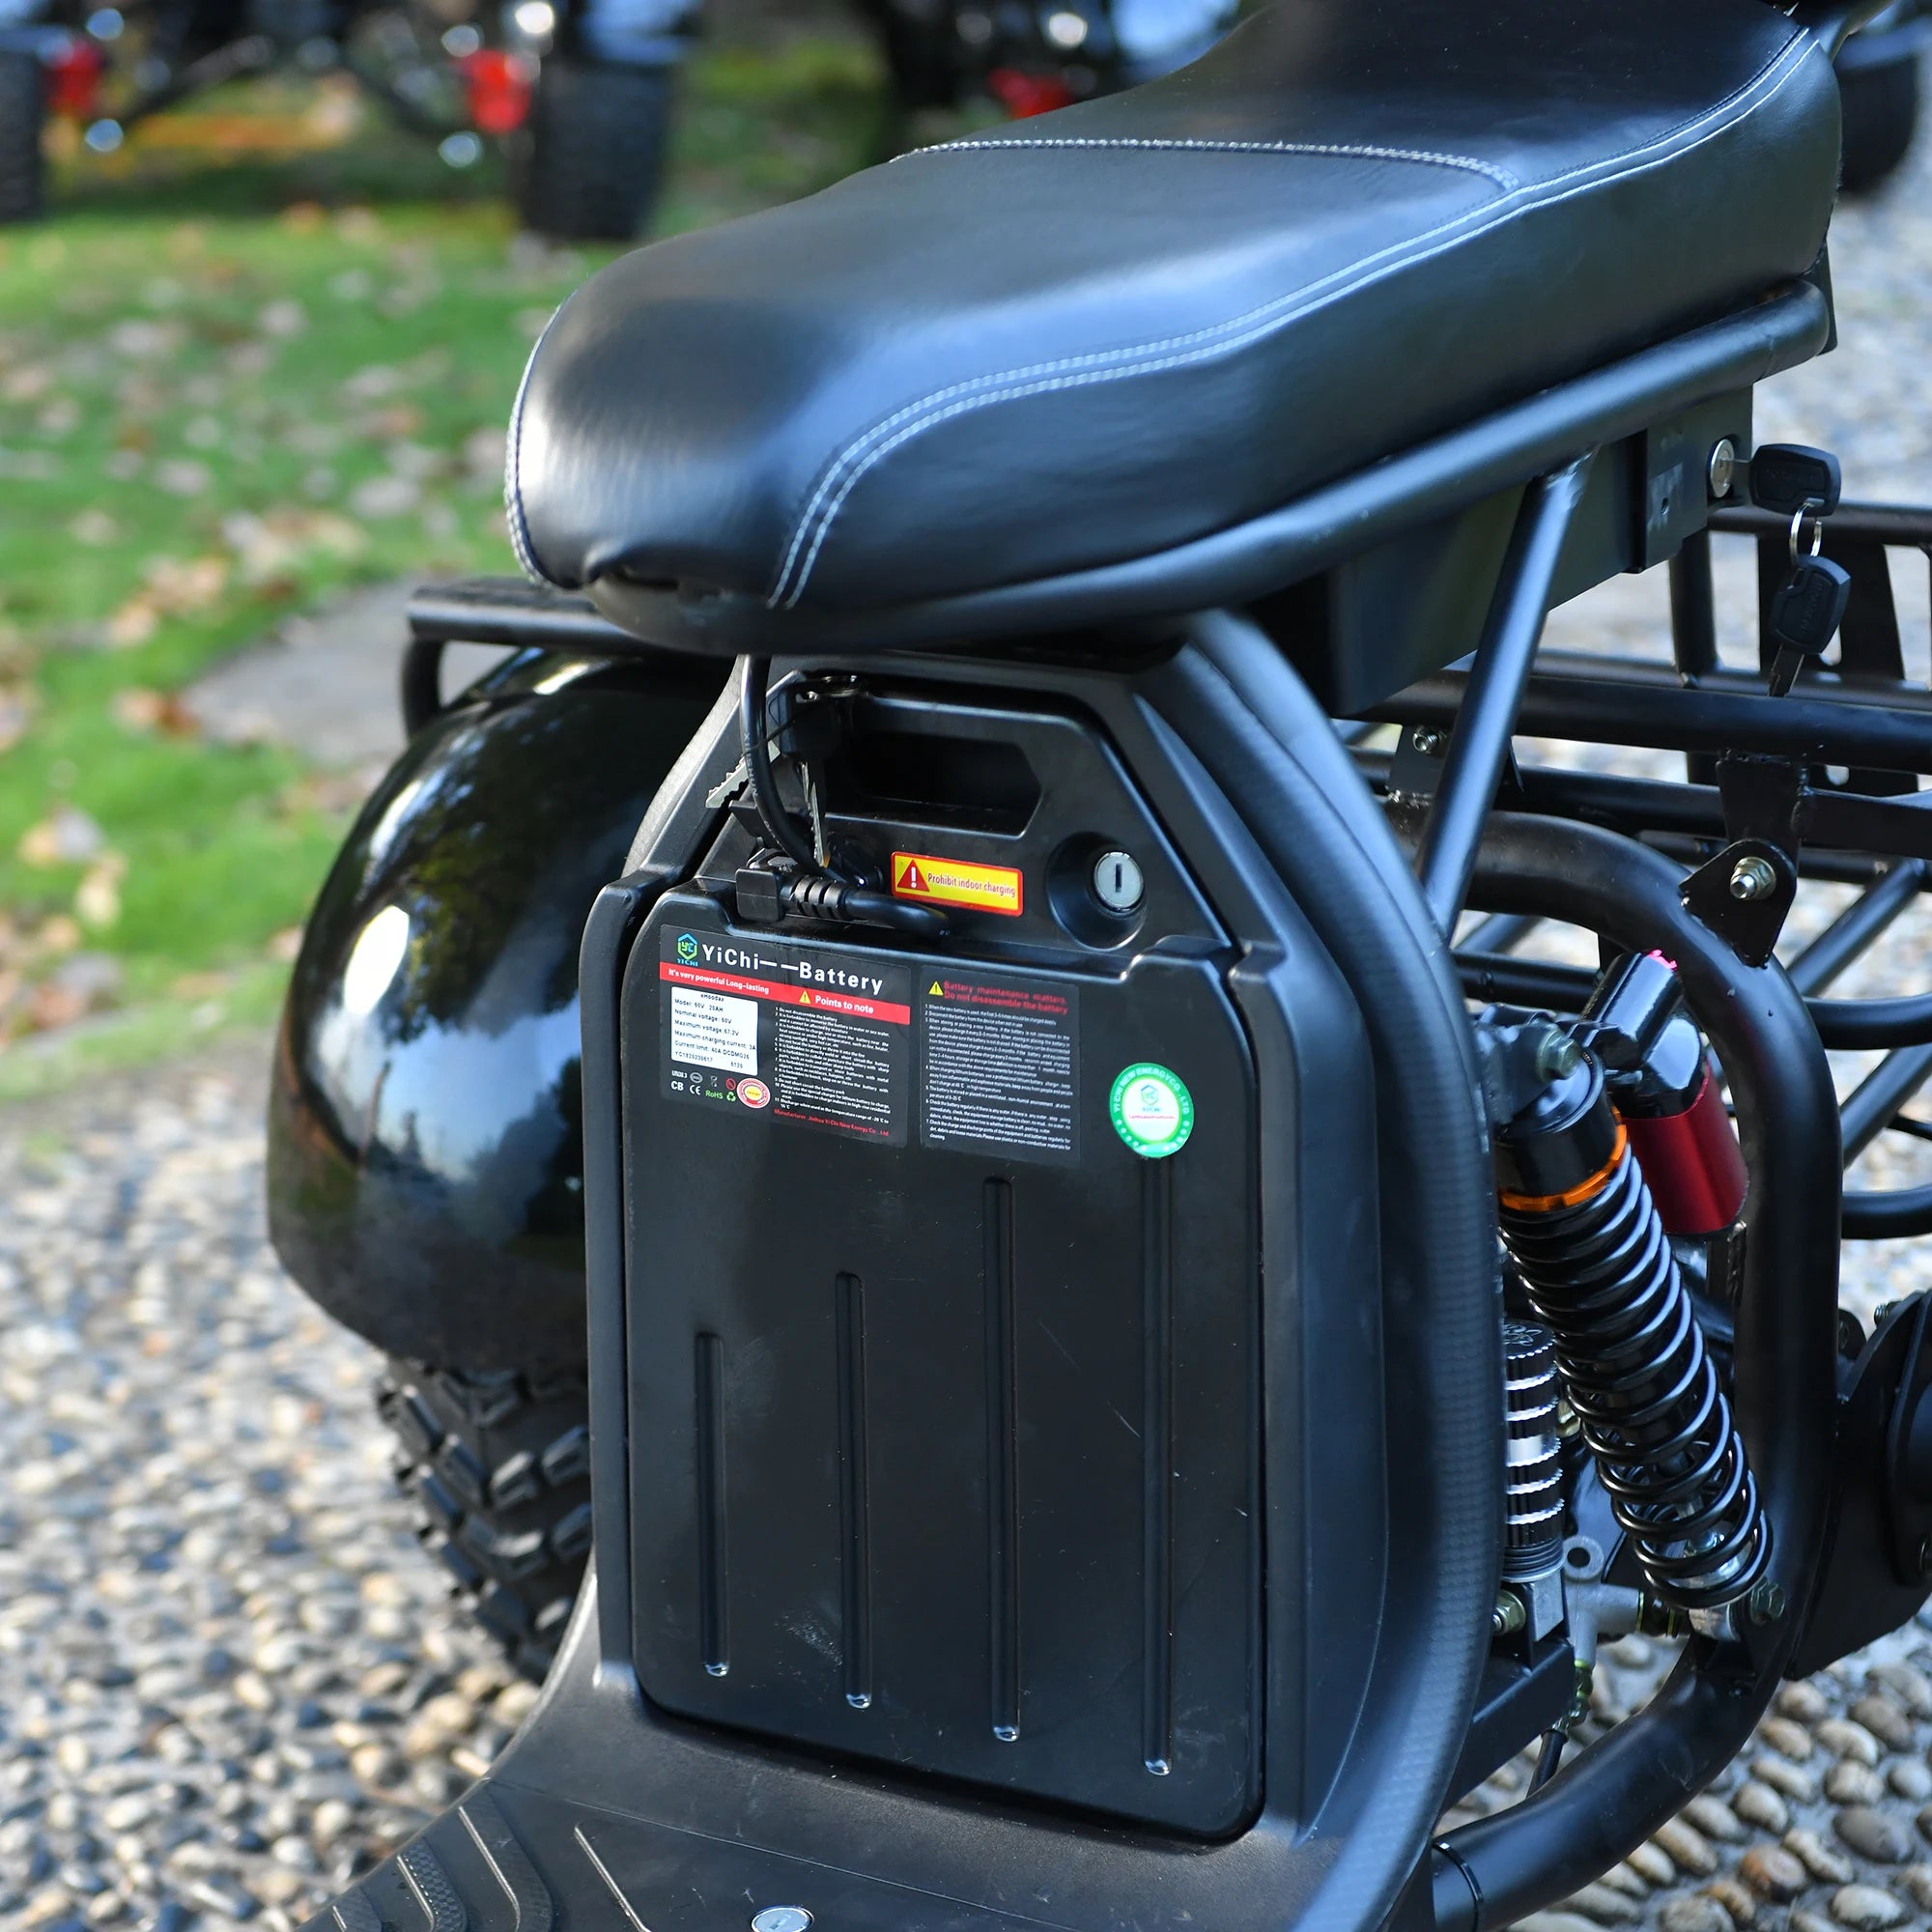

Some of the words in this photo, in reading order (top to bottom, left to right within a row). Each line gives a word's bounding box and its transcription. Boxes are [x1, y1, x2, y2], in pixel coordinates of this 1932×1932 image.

[927, 872, 956, 886] Prohibit
[958, 879, 982, 891] indoor
[983, 883, 1016, 898] charging
[676, 957, 698, 967] YICHI
[668, 968, 679, 978] It's
[680, 971, 695, 981] very
[695, 974, 725, 985] powerful
[725, 979, 769, 995] Long-lasting
[815, 995, 842, 1009] Points
[843, 1000, 852, 1009] to
[854, 1003, 874, 1014] note
[674, 1019, 701, 1030] Maximum
[674, 1030, 701, 1040] Maximum
[702, 1035, 725, 1046] charging
[670, 1080, 684, 1092] CB
[705, 1090, 724, 1099] RoHS
